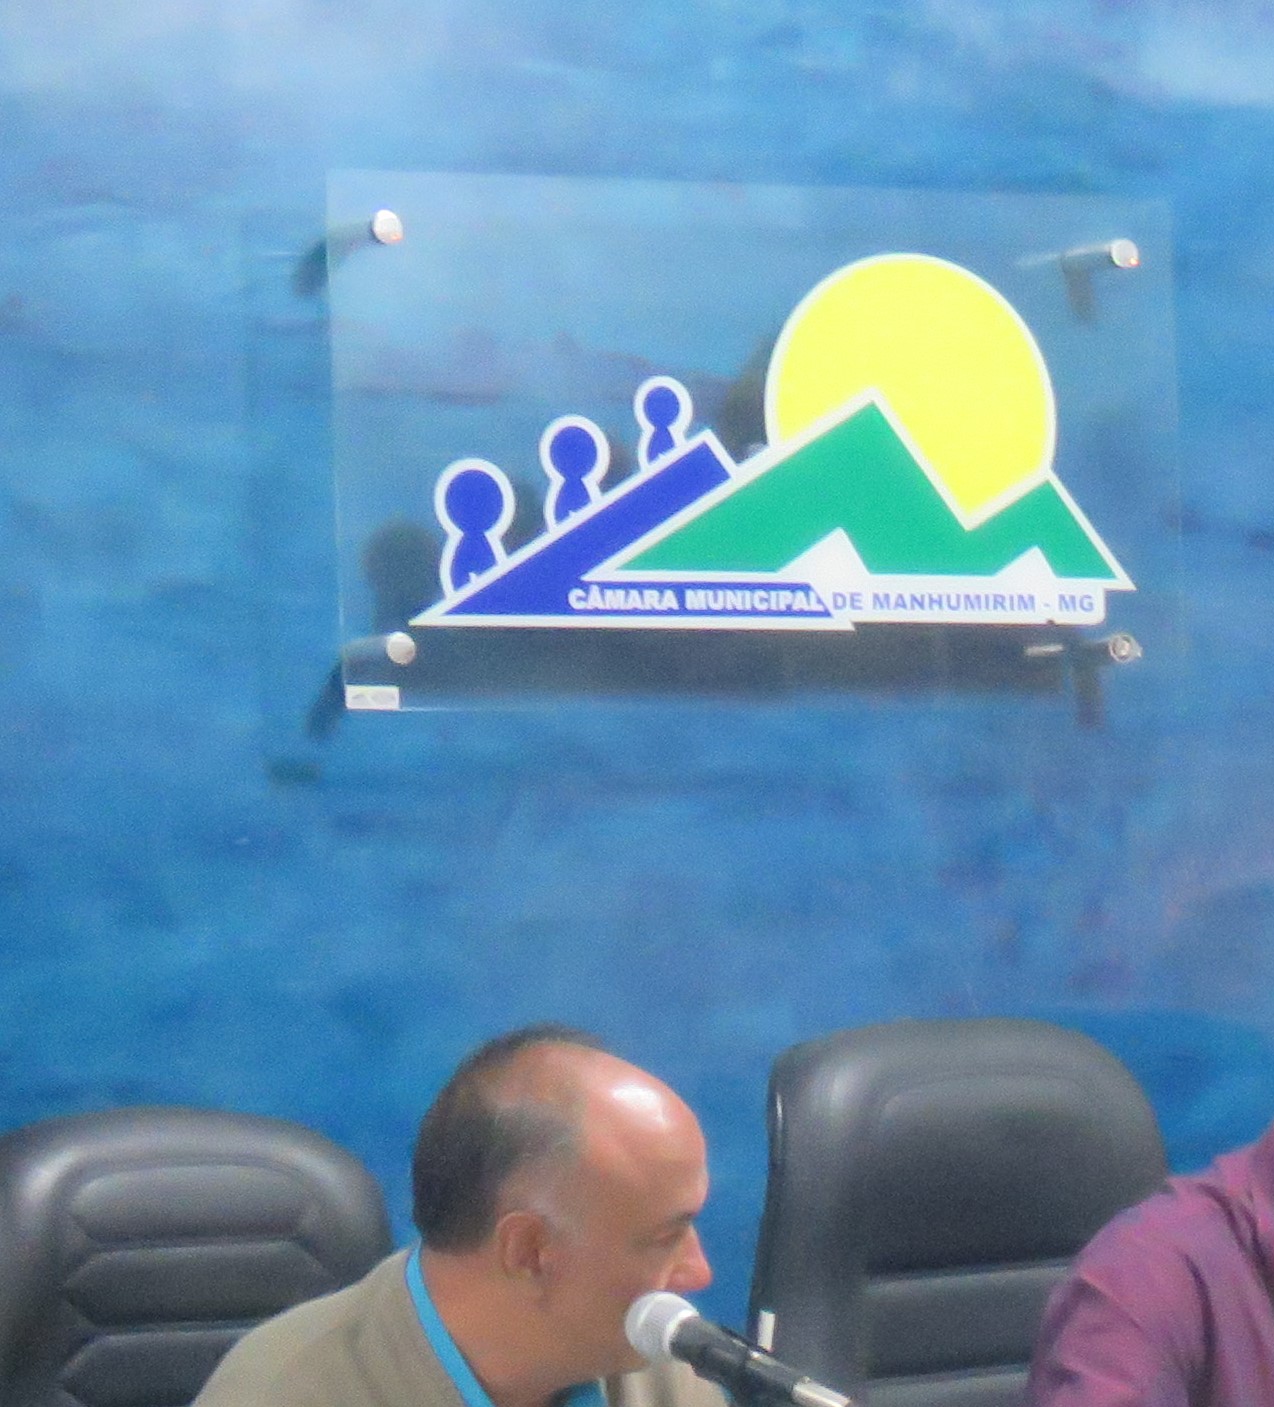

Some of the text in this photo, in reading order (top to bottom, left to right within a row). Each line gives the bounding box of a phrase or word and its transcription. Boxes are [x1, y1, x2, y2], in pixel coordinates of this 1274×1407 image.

[567, 584, 679, 611] CÂMARA
[684, 588, 825, 612] MUNICIPAL
[831, 592, 863, 611] DE
[872, 592, 1036, 612] MANHUMIRIM
[1058, 593, 1095, 612] MG
